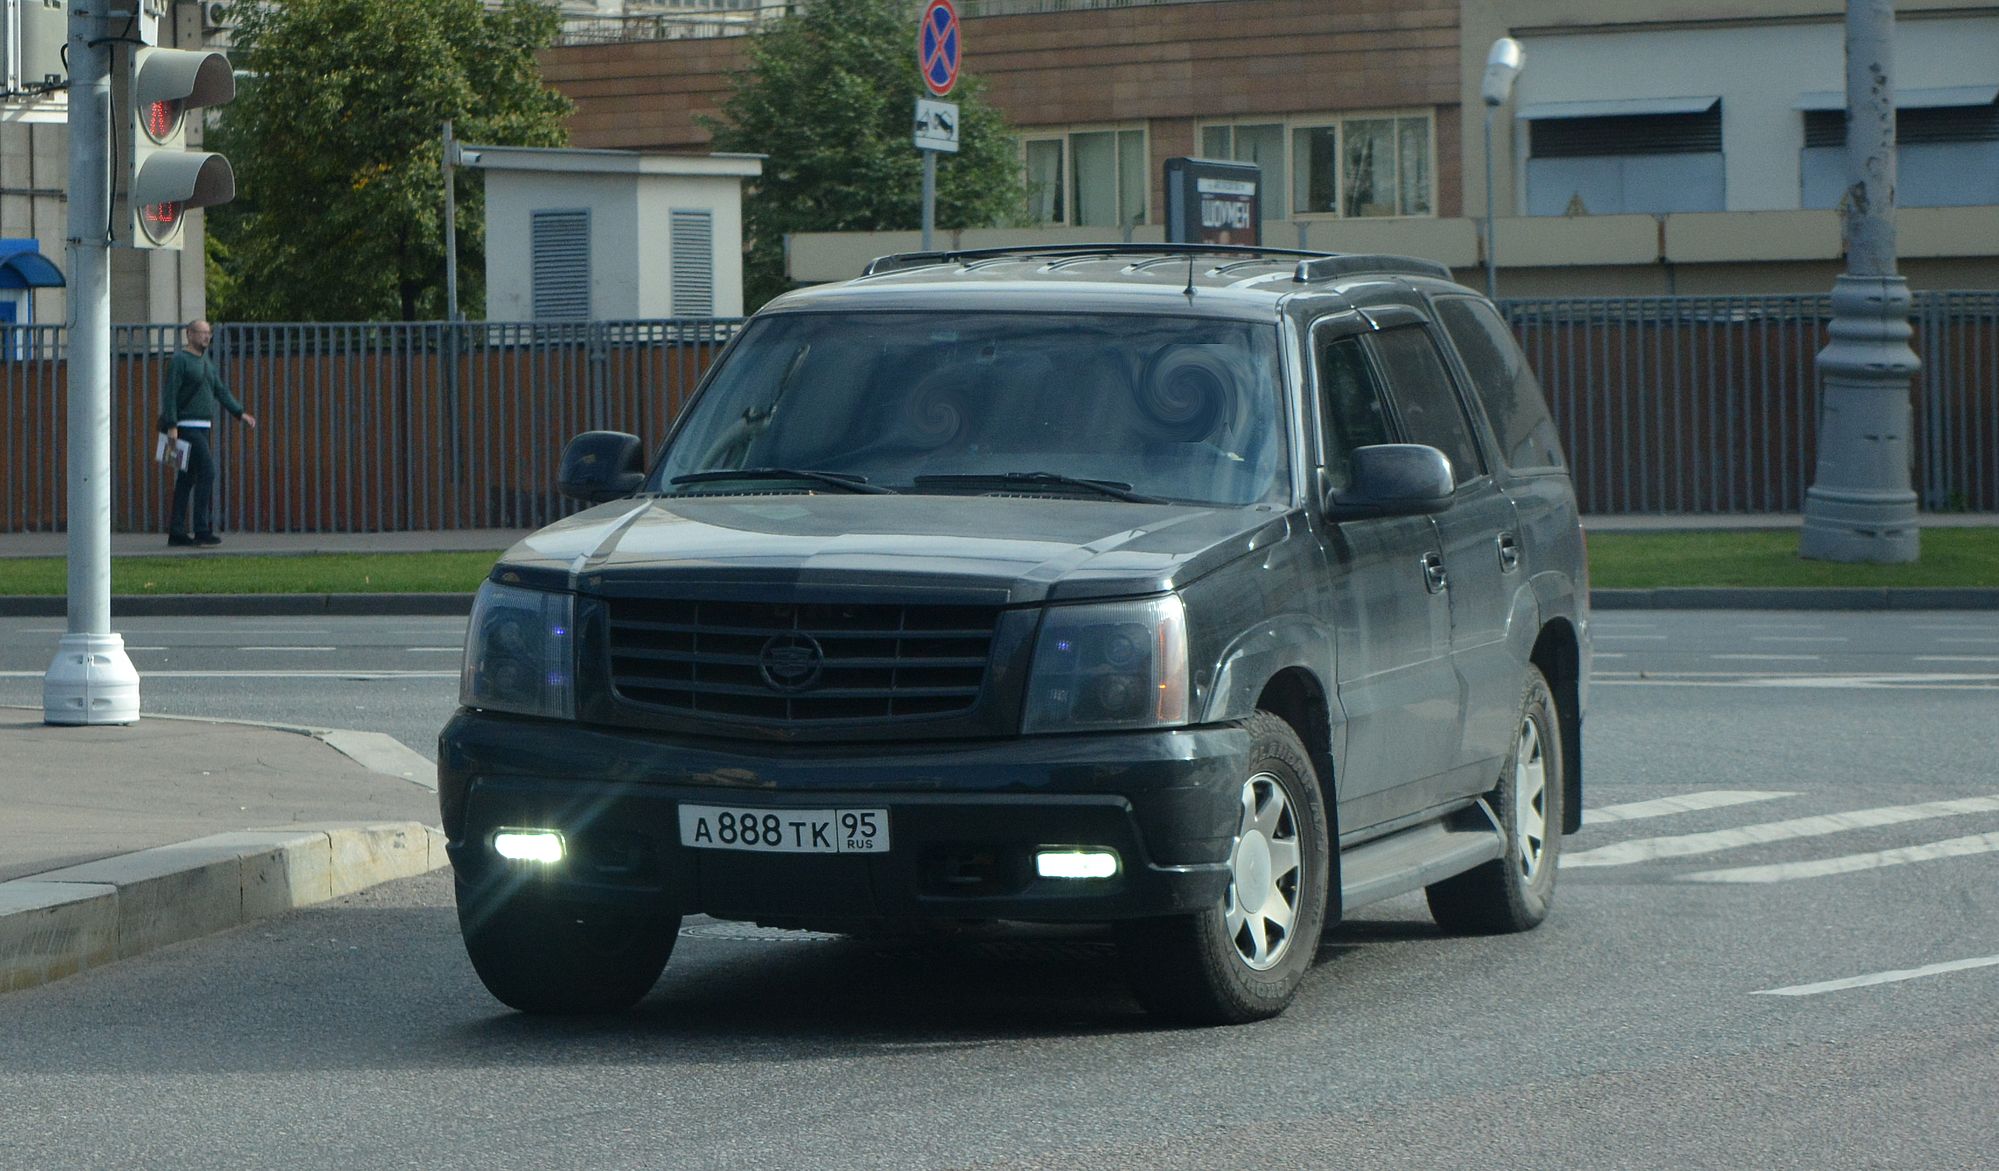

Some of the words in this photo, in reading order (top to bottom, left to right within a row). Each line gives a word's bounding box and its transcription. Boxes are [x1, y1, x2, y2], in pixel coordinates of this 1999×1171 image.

[695, 812, 831, 847] A888TK
[841, 812, 877, 838] 95
[847, 839, 873, 849] RUS
